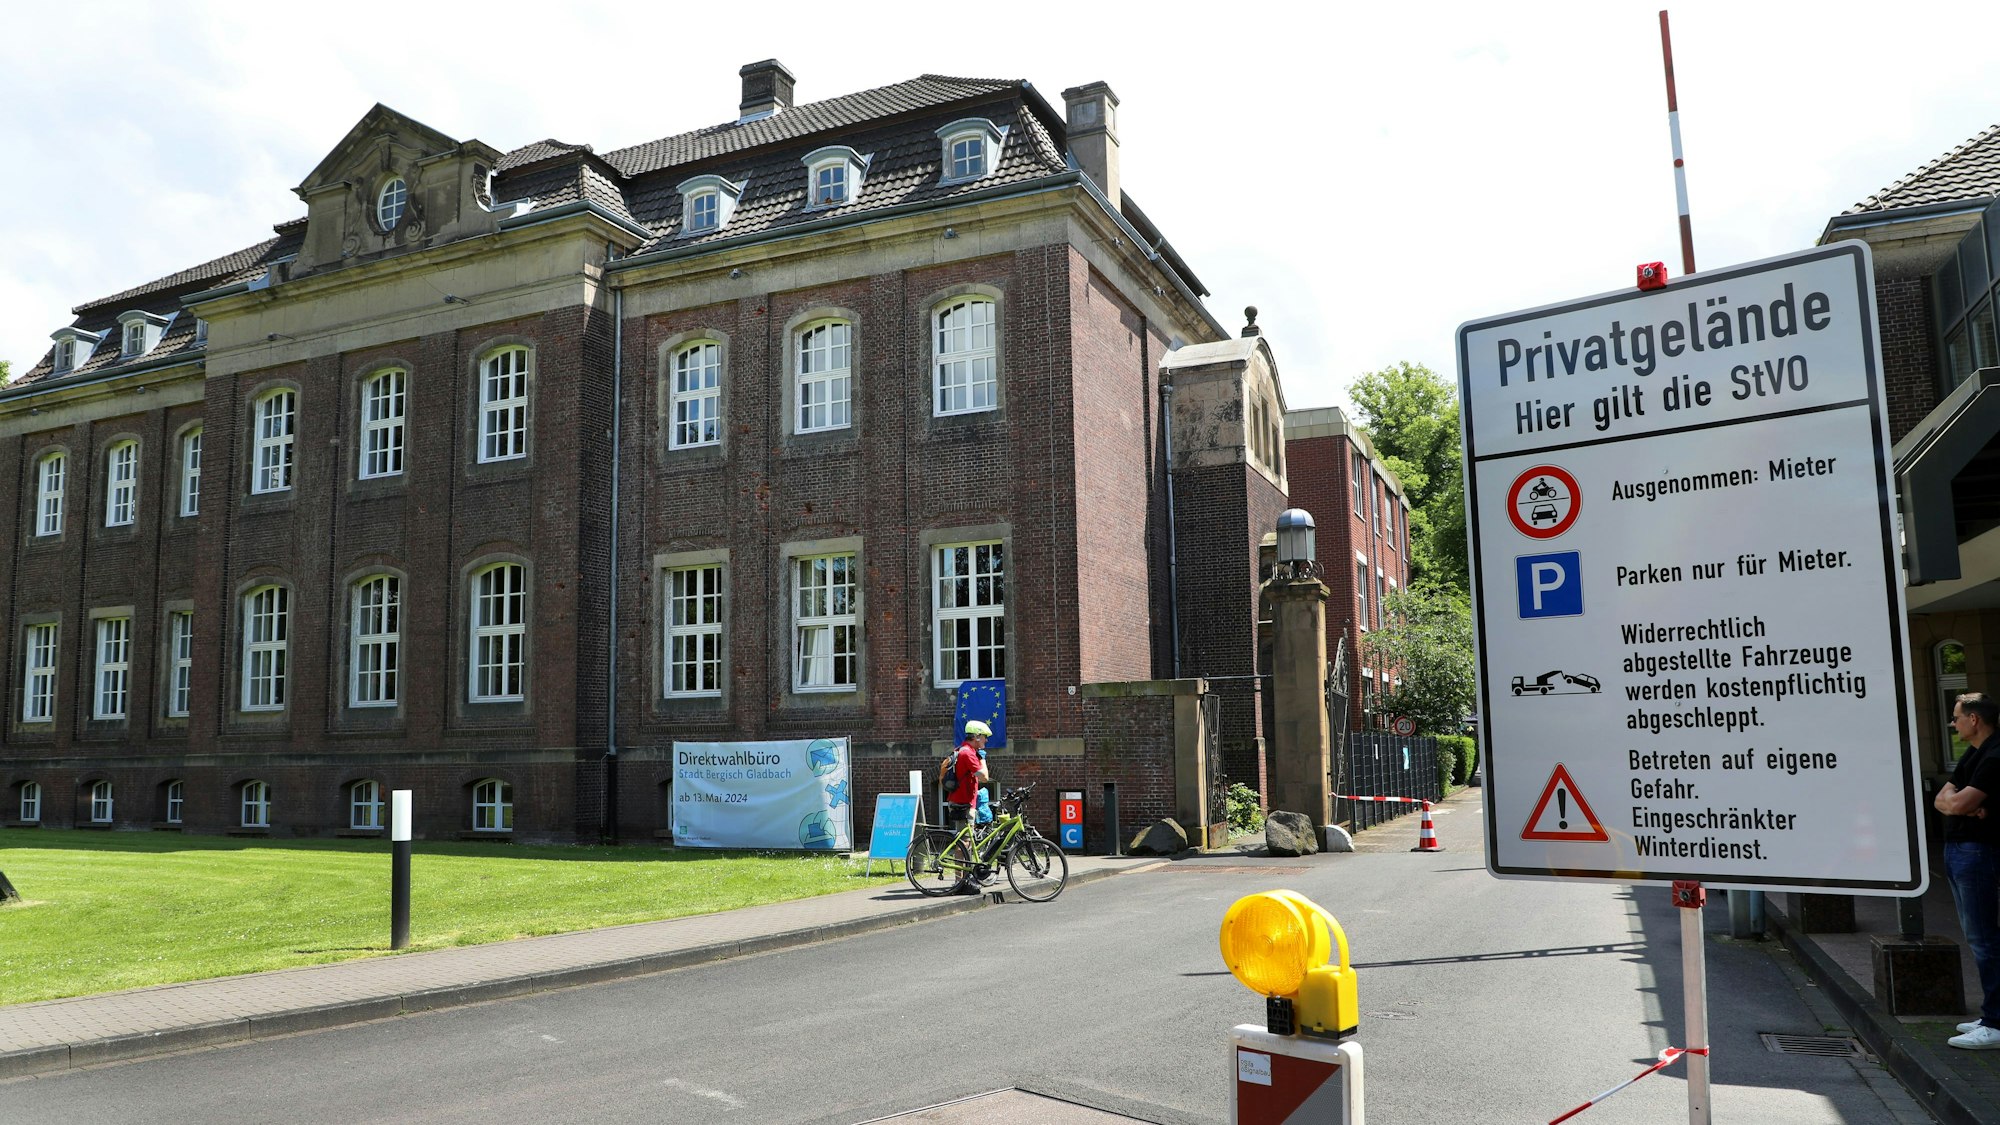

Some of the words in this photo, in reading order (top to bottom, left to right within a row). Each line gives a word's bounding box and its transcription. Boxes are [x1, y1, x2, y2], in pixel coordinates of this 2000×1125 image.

[1497, 282, 1831, 388] Privatgelände
[1515, 400, 1576, 435] Hier
[1593, 384, 1645, 432] gilt
[1662, 374, 1712, 412] die
[1730, 354, 1809, 401] StVO
[1611, 470, 1759, 502] Ausgenommen:
[1768, 456, 1837, 482] Mieter
[1616, 563, 1682, 587] Parken
[1692, 562, 1725, 582] nur
[1736, 553, 1767, 577] für
[1778, 548, 1852, 573] Mieter.
[1531, 561, 1567, 611] P
[1620, 615, 1766, 645] Widerrechtlich
[1623, 648, 1732, 675] abgestellte
[1742, 644, 1853, 670] Fahrzeuge
[1624, 678, 1697, 701] werden
[1706, 670, 1867, 702] kostenpflichtig
[1399, 721, 1411, 731] 20
[1626, 706, 1765, 735] abgeschleppt.
[679, 751, 781, 766] Direktwahlbüro
[1628, 747, 1711, 771] Betreten
[1721, 747, 1755, 770] auf
[1766, 747, 1837, 776] eigene
[679, 769, 704, 779] Stadt
[706, 769, 743, 782] Bergisch
[746, 769, 792, 780] Gladbach
[1630, 777, 1699, 800] Gefahr.
[679, 792, 691, 803] ab
[724, 793, 748, 803] 2024
[1066, 804, 1077, 820] B
[1632, 806, 1797, 834] Eingeschränkter
[1066, 828, 1078, 844] C
[1634, 835, 1768, 860] Winterdienst.
